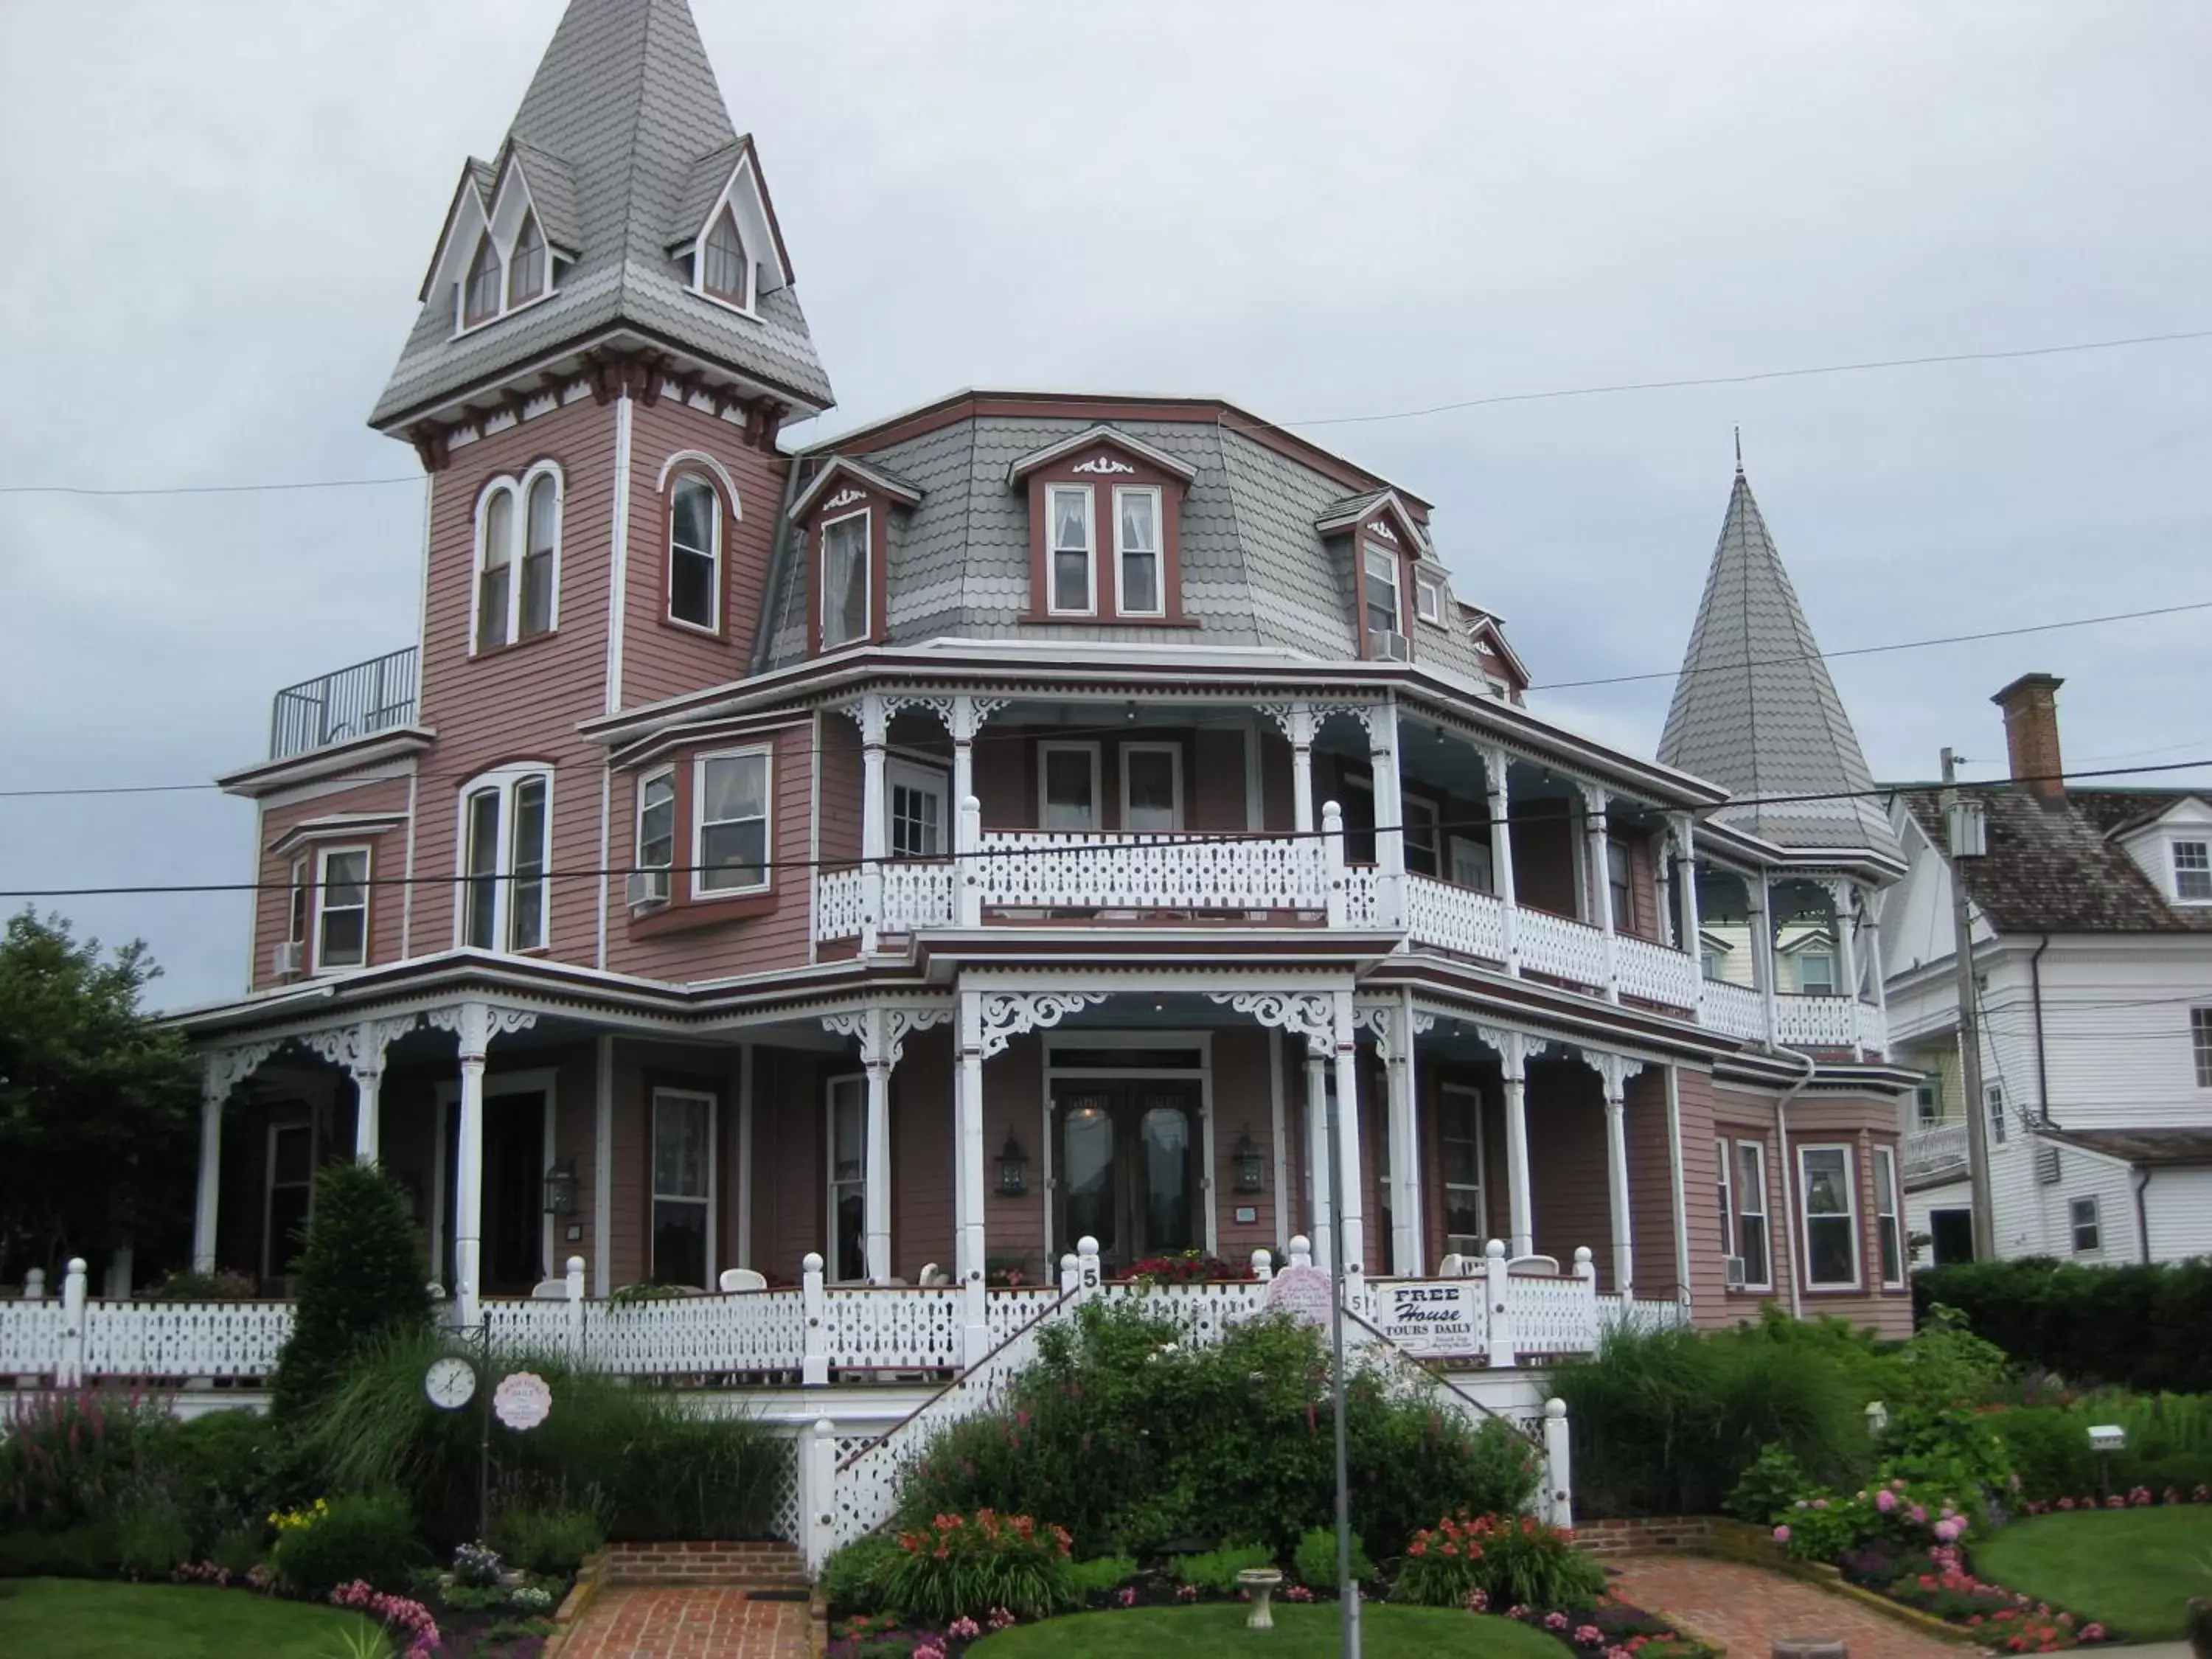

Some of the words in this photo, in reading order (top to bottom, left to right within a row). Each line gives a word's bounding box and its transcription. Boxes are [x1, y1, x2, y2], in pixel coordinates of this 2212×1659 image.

[1085, 1269, 1097, 1288] 5
[1394, 1288, 1459, 1303] FREE
[1394, 1303, 1461, 1323] House
[1384, 1324, 1429, 1336] TOURS
[1434, 1323, 1472, 1335] DAILY
